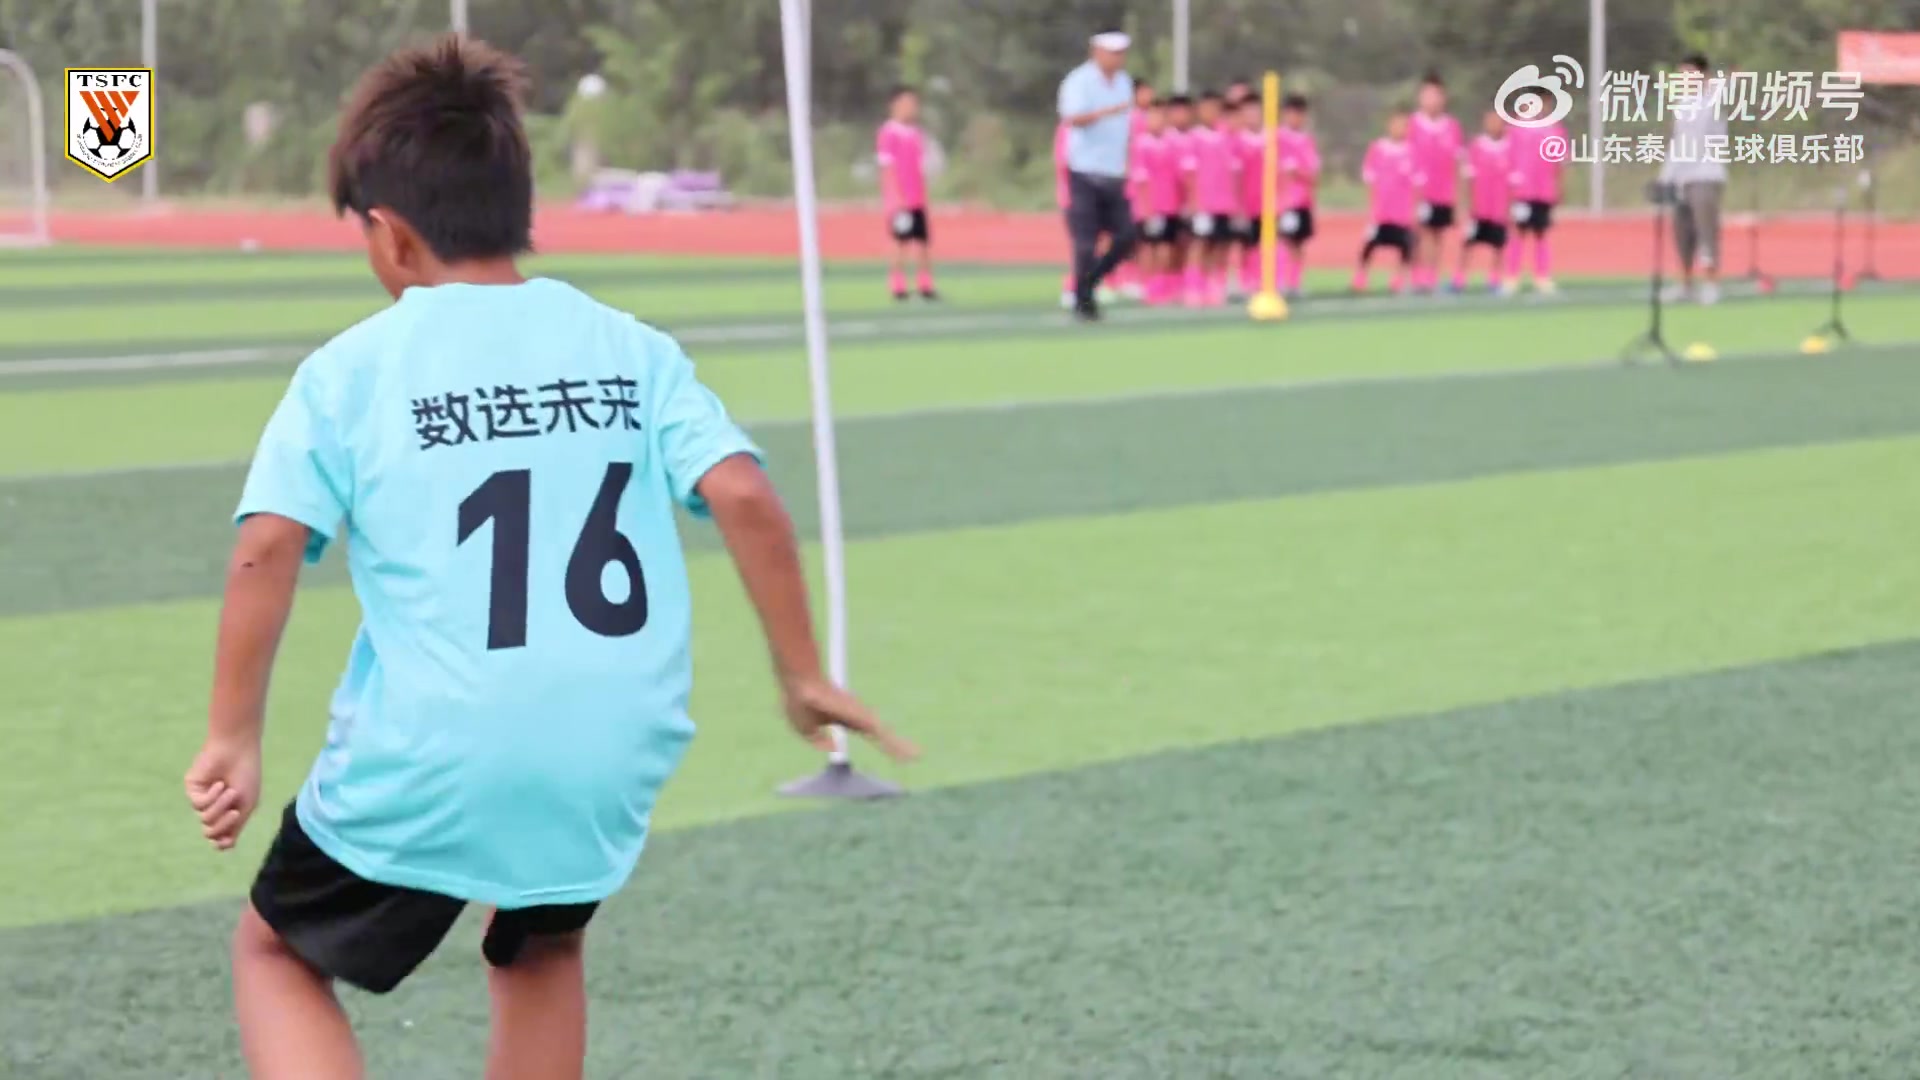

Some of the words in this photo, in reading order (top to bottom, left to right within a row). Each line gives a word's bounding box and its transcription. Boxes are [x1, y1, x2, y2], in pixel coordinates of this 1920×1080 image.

[411, 375, 642, 450] 数选未来
[456, 462, 648, 651] 16
